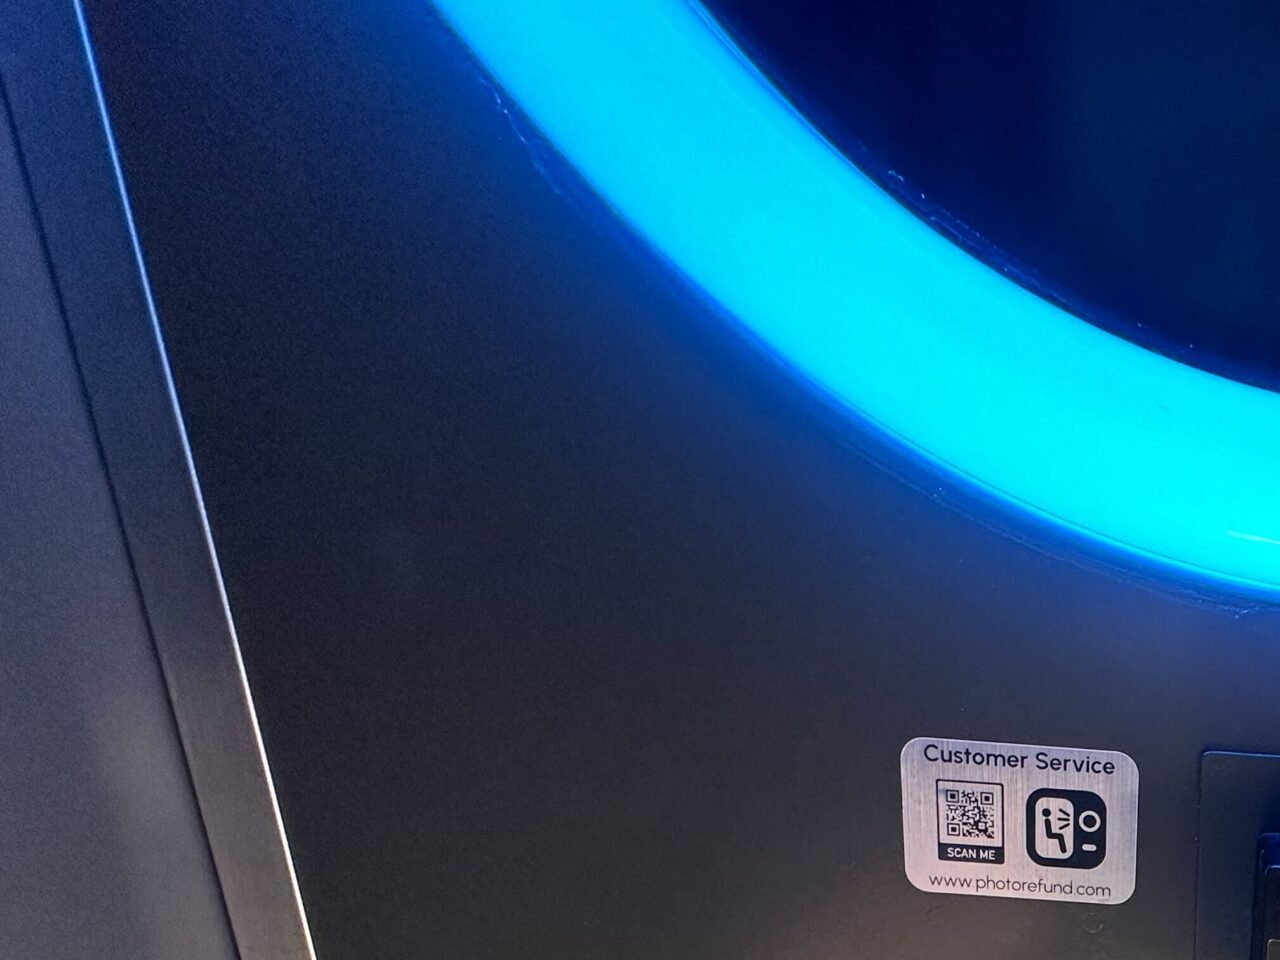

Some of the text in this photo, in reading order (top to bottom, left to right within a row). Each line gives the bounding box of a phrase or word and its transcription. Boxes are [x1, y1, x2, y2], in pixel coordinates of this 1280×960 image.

[924, 744, 1116, 775] Customer Service
[947, 847, 996, 861] SCAN ME
[929, 874, 1111, 897] www.photorefund.com
